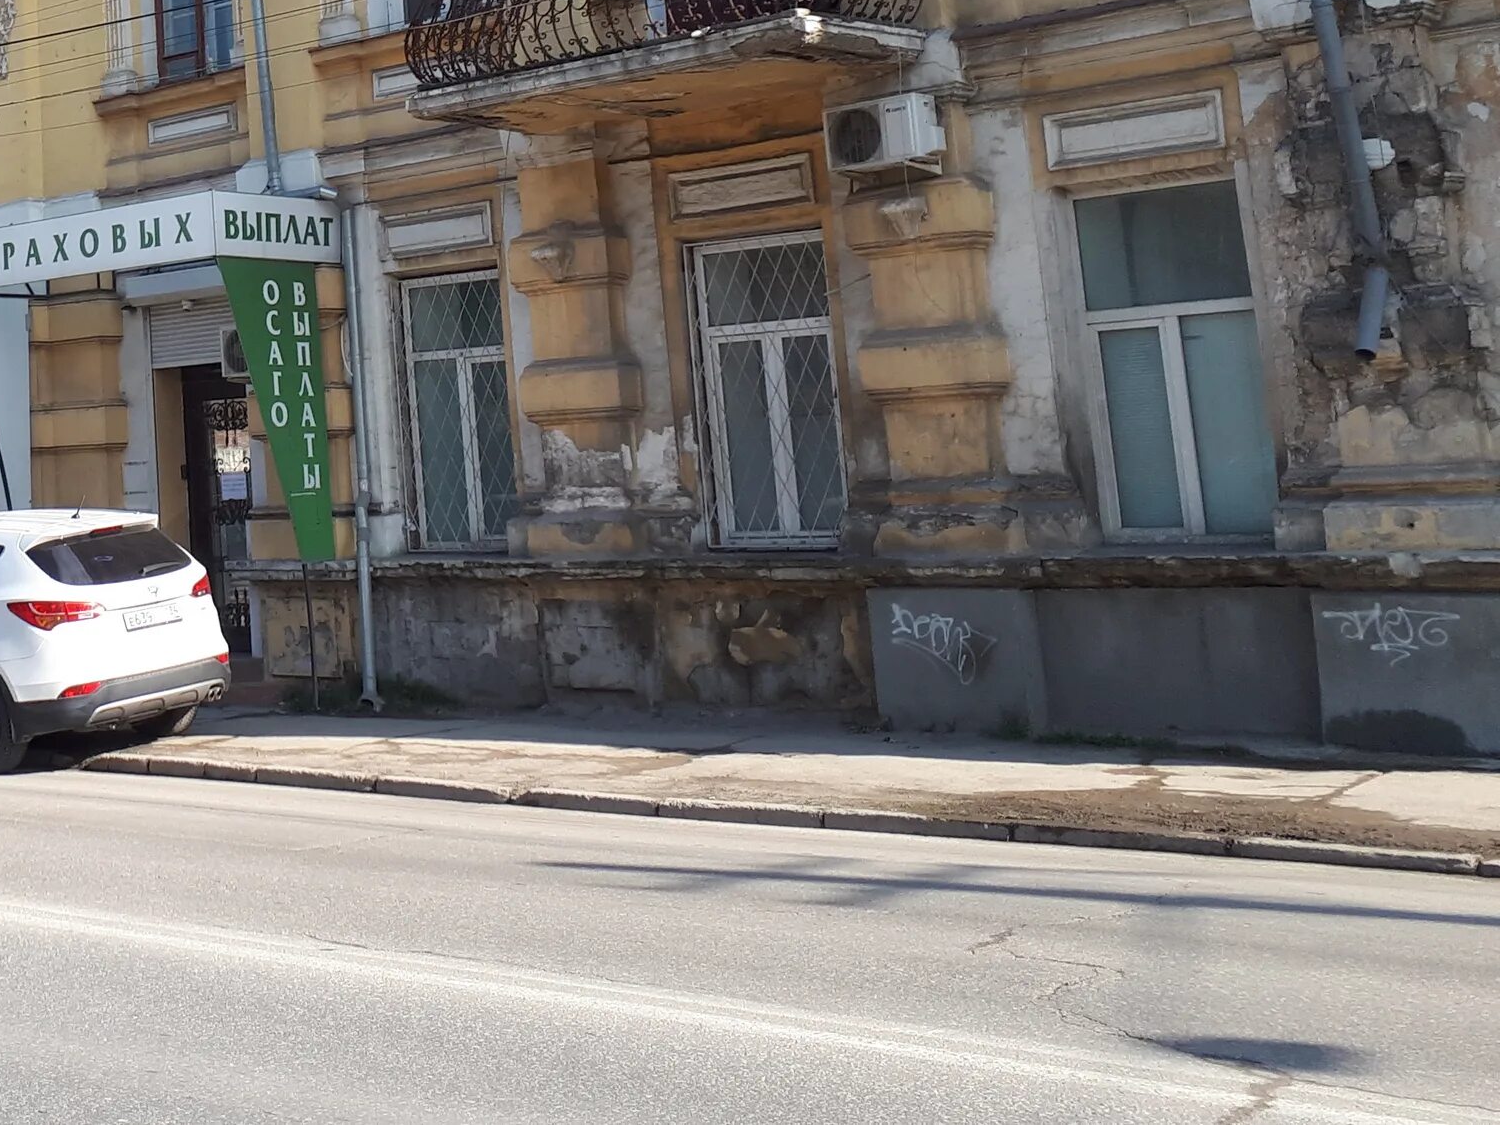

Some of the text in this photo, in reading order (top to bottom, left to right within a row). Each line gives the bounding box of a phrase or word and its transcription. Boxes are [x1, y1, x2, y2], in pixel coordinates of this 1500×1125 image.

[223, 208, 334, 247] ВЫПЛАТ
[262, 279, 289, 428] ОСАГО
[292, 281, 321, 490] ВЫПЛАТЫ
